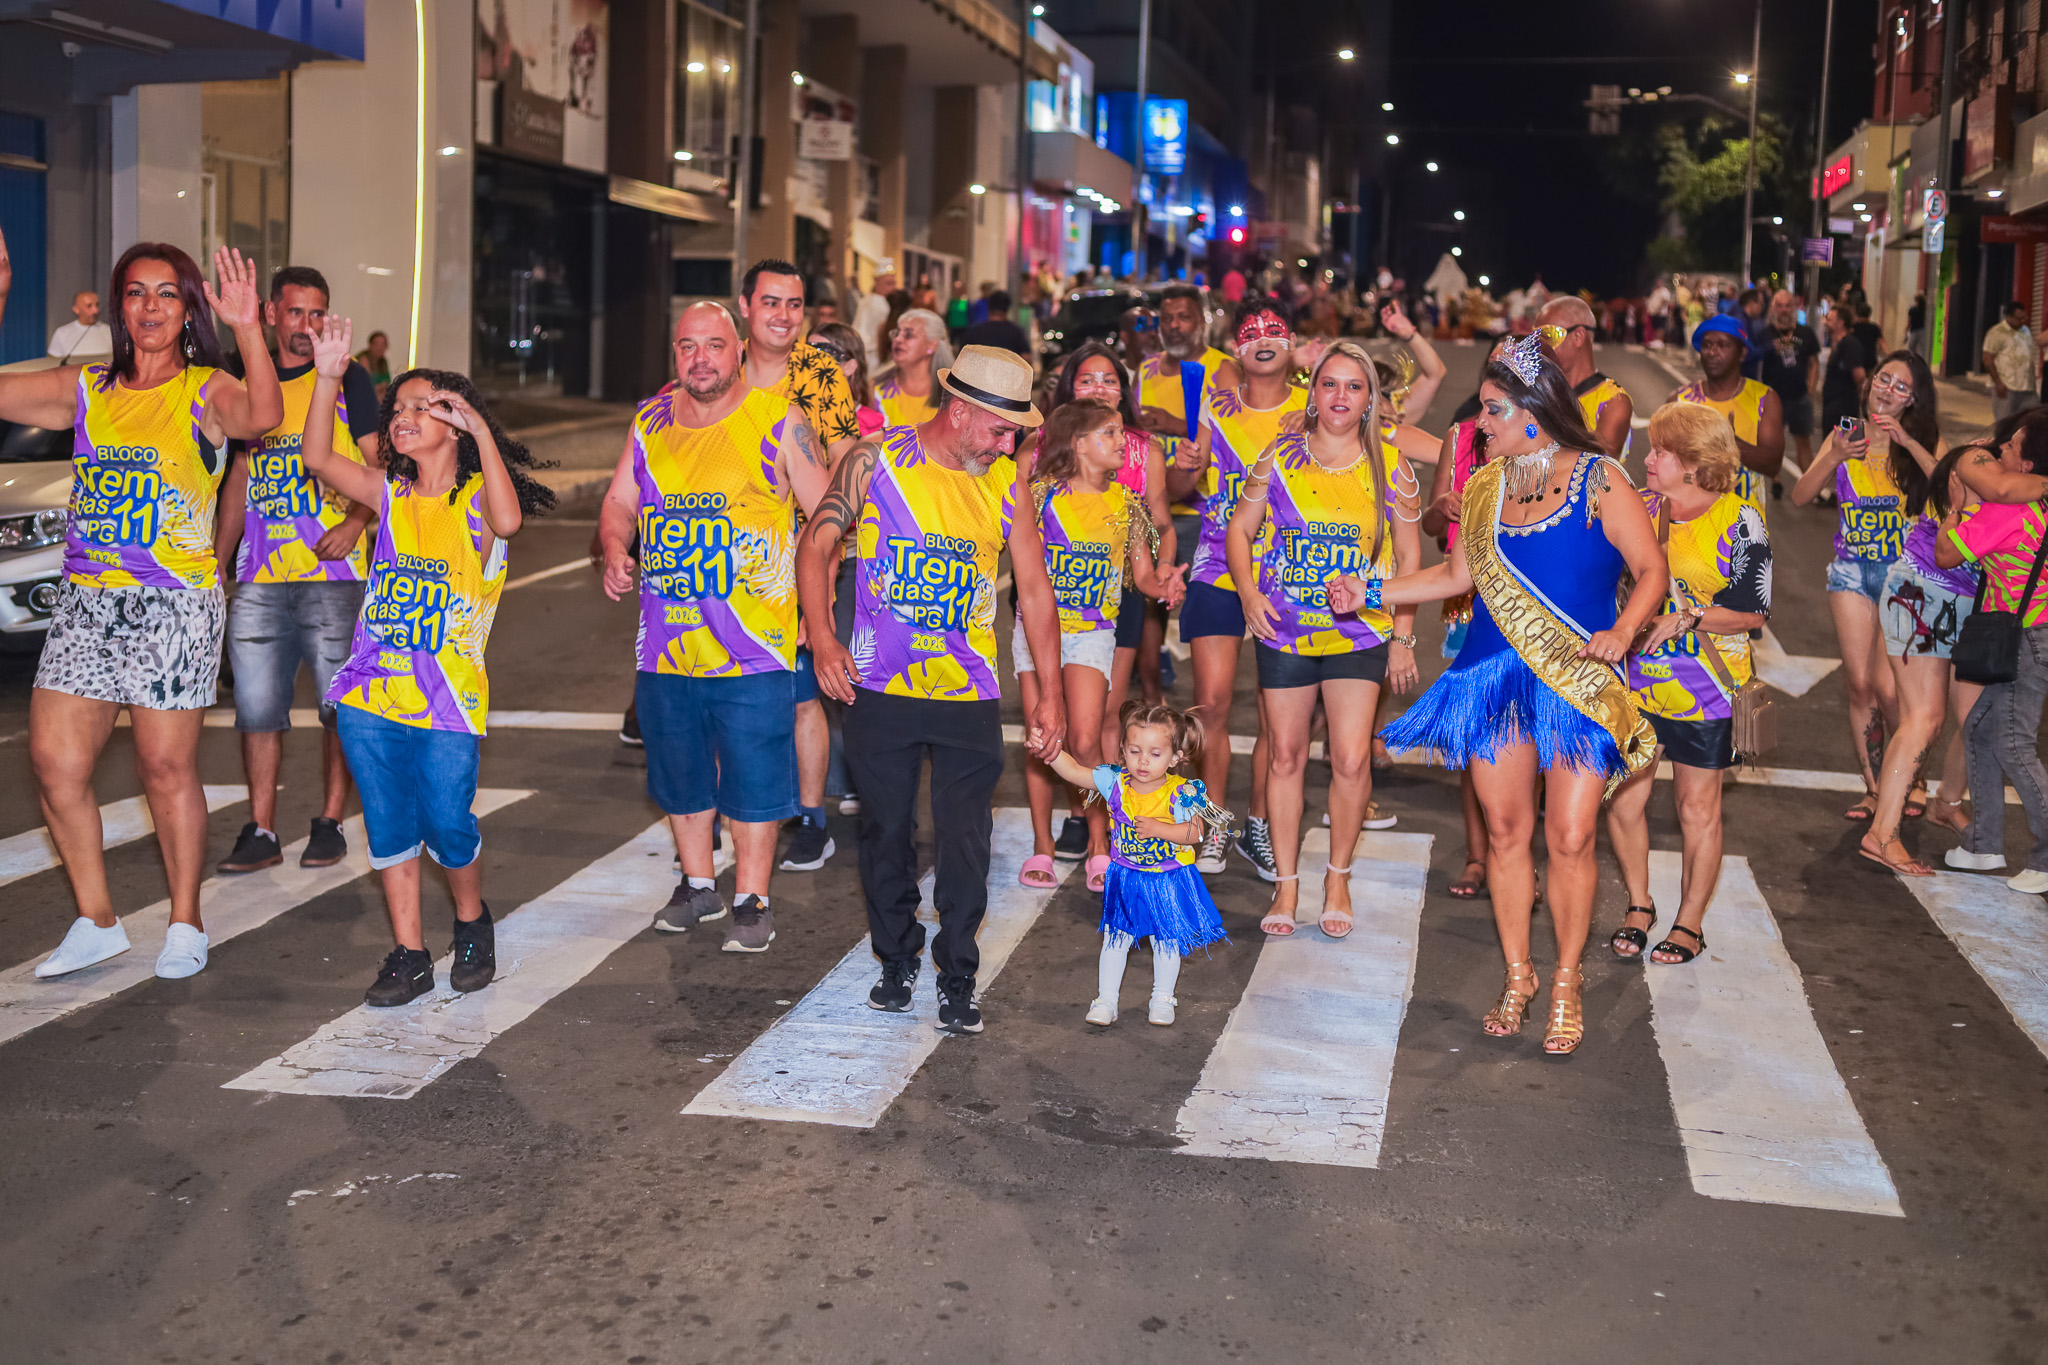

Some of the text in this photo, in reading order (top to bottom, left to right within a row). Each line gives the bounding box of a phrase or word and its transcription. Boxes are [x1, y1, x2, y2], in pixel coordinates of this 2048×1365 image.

[96, 446, 158, 463] BLOCO
[73, 456, 160, 501] Trem
[250, 477, 317, 515] das 11
[663, 494, 726, 510] BLOCO
[1860, 496, 1899, 506] BLOCO
[75, 496, 153, 544] das 11
[266, 500, 289, 518] PG
[1841, 502, 1903, 530] Trem
[86, 519, 116, 543] PG
[267, 524, 298, 540] 2026
[642, 505, 731, 549] Trem
[1309, 522, 1360, 539] BLOCO
[925, 534, 976, 555] BLOCO
[1071, 541, 1111, 554] BLOCO
[1281, 528, 1360, 570] Trem
[1857, 545, 1879, 560] PG
[1874, 529, 1902, 557] 11
[396, 553, 449, 574] BLOCO
[682, 548, 727, 596] 11
[888, 538, 978, 589] Trem
[1046, 544, 1111, 578] Trem
[1468, 522, 1507, 600] RAINHA
[1500, 597, 1527, 622] DO
[1283, 564, 1319, 583] das
[375, 561, 449, 610] Trem
[660, 575, 691, 599] PG
[1079, 577, 1105, 607] 11
[890, 580, 972, 629] das 11
[1059, 590, 1081, 607] PG
[1300, 587, 1327, 607] PG
[367, 600, 441, 651] das 11
[663, 604, 703, 625] 2026
[914, 605, 942, 628] PG
[1298, 611, 1334, 628] 2026
[382, 624, 408, 647] PG
[911, 632, 947, 653] 2026
[378, 651, 413, 673] 2026
[1639, 661, 1673, 679] 2026
[1121, 842, 1146, 855] das
